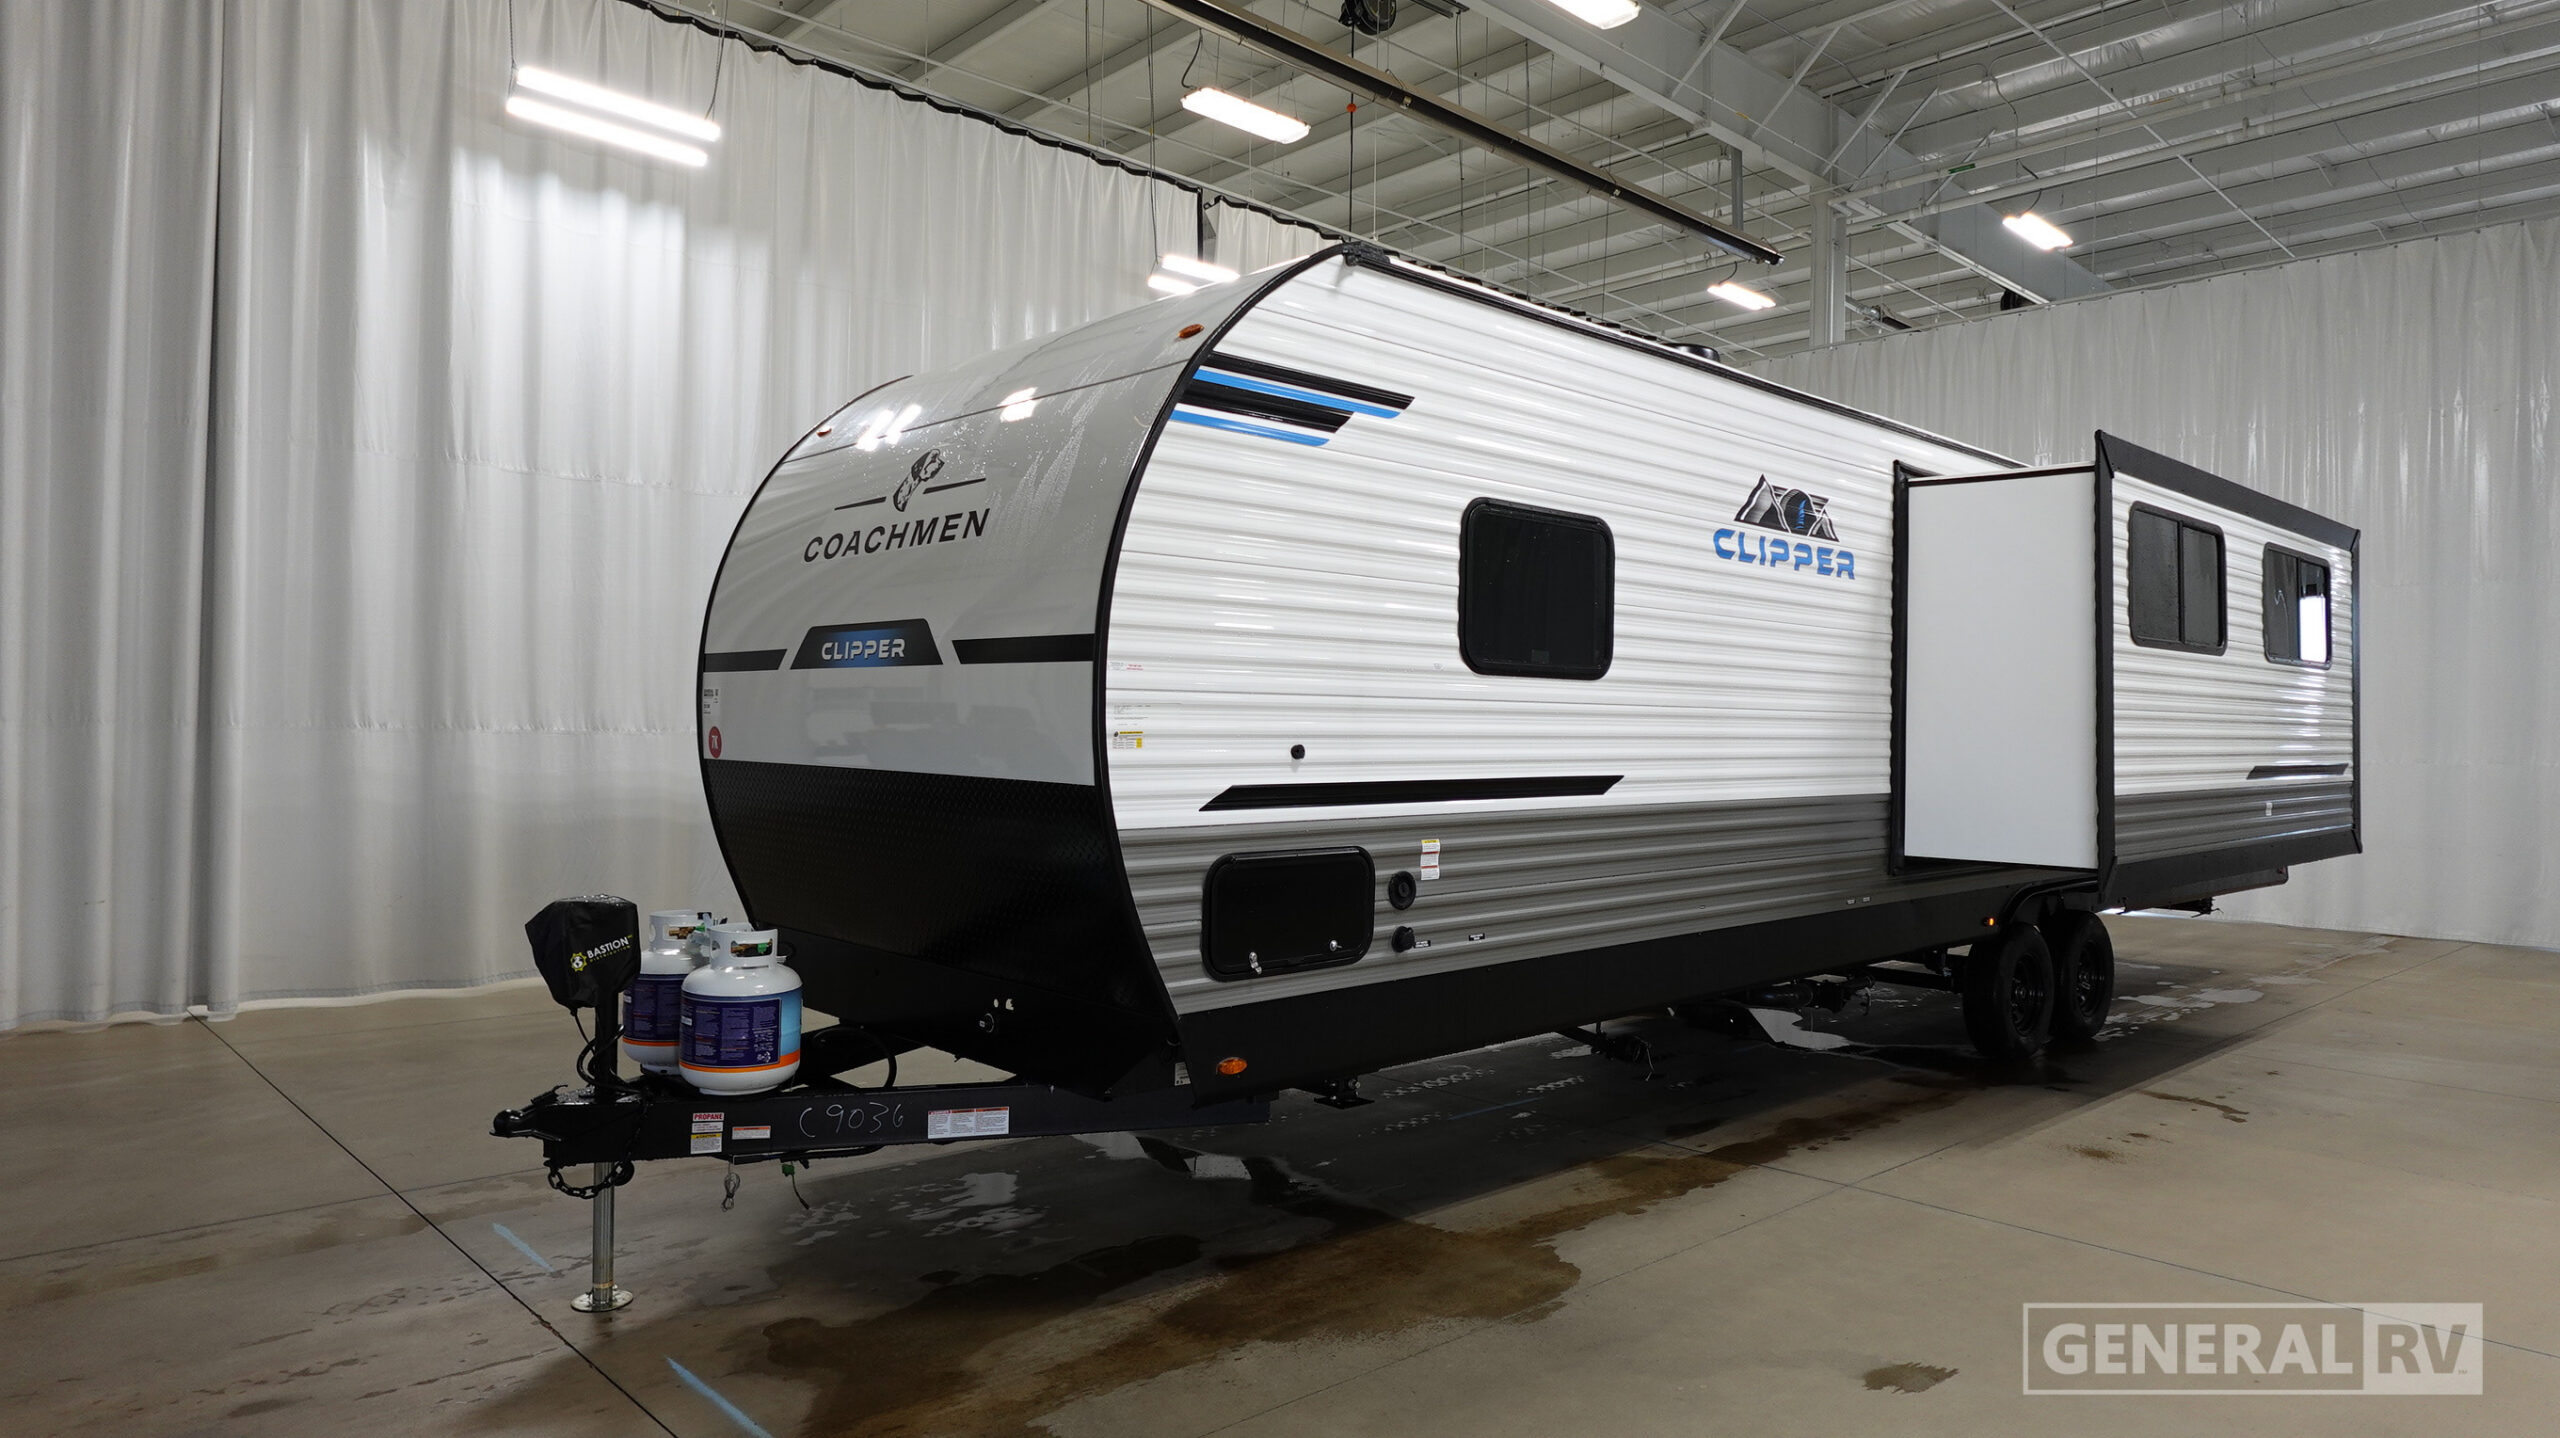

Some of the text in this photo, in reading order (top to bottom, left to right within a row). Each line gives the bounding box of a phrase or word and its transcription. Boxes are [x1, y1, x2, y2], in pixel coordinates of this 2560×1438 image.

[804, 508, 990, 562] COACHMEN
[1713, 528, 1855, 580] CLIPPER
[821, 638, 905, 660] CLIPPER
[587, 936, 629, 959] BASTION
